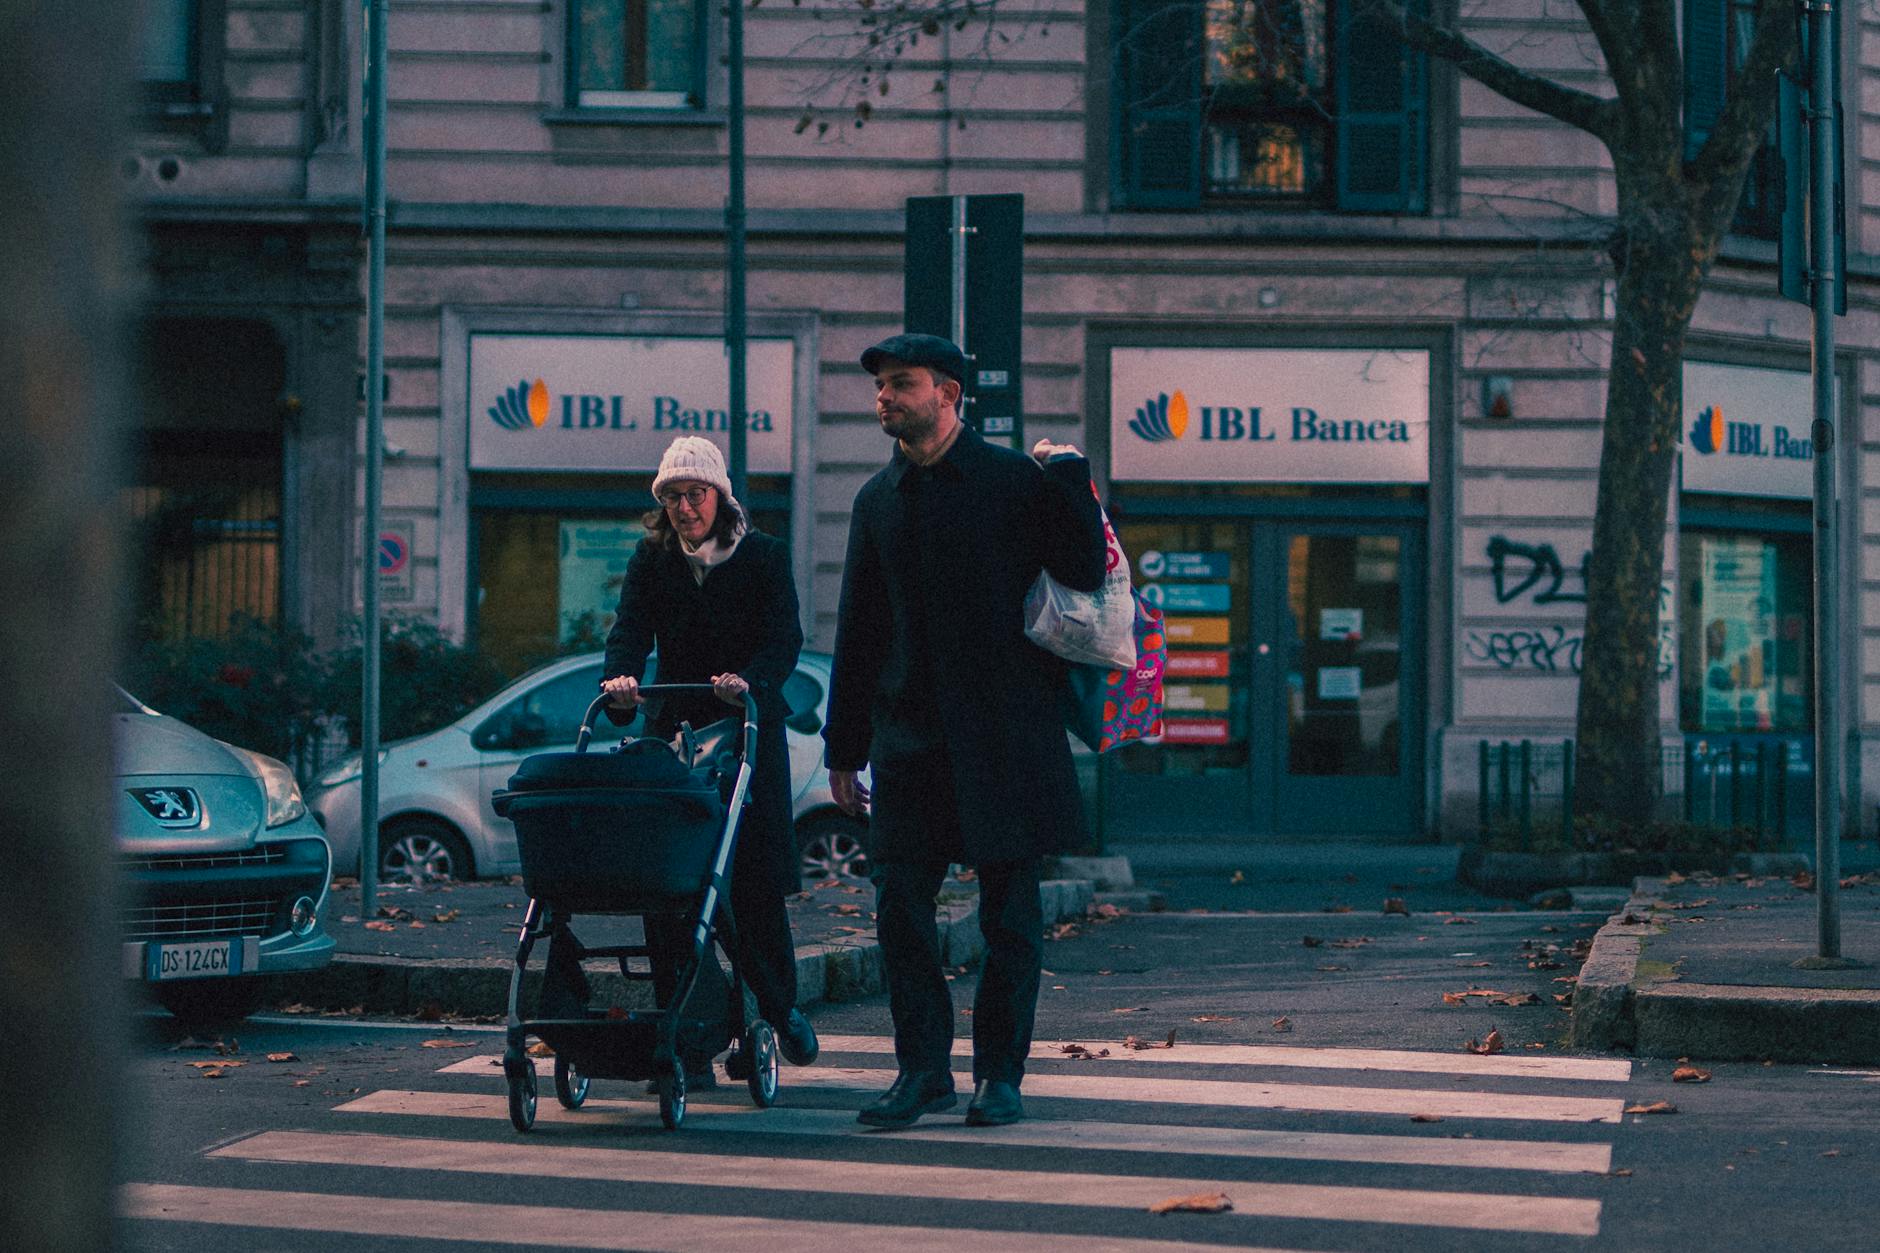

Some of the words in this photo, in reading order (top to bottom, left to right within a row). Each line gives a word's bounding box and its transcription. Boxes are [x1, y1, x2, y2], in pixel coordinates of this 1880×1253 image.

[559, 394, 637, 430] IBL
[653, 396, 774, 433] Bana
[1199, 406, 1276, 442] IBL
[1290, 407, 1411, 443] Banca
[1727, 421, 1769, 456] IBL
[1773, 425, 1813, 460] Ban
